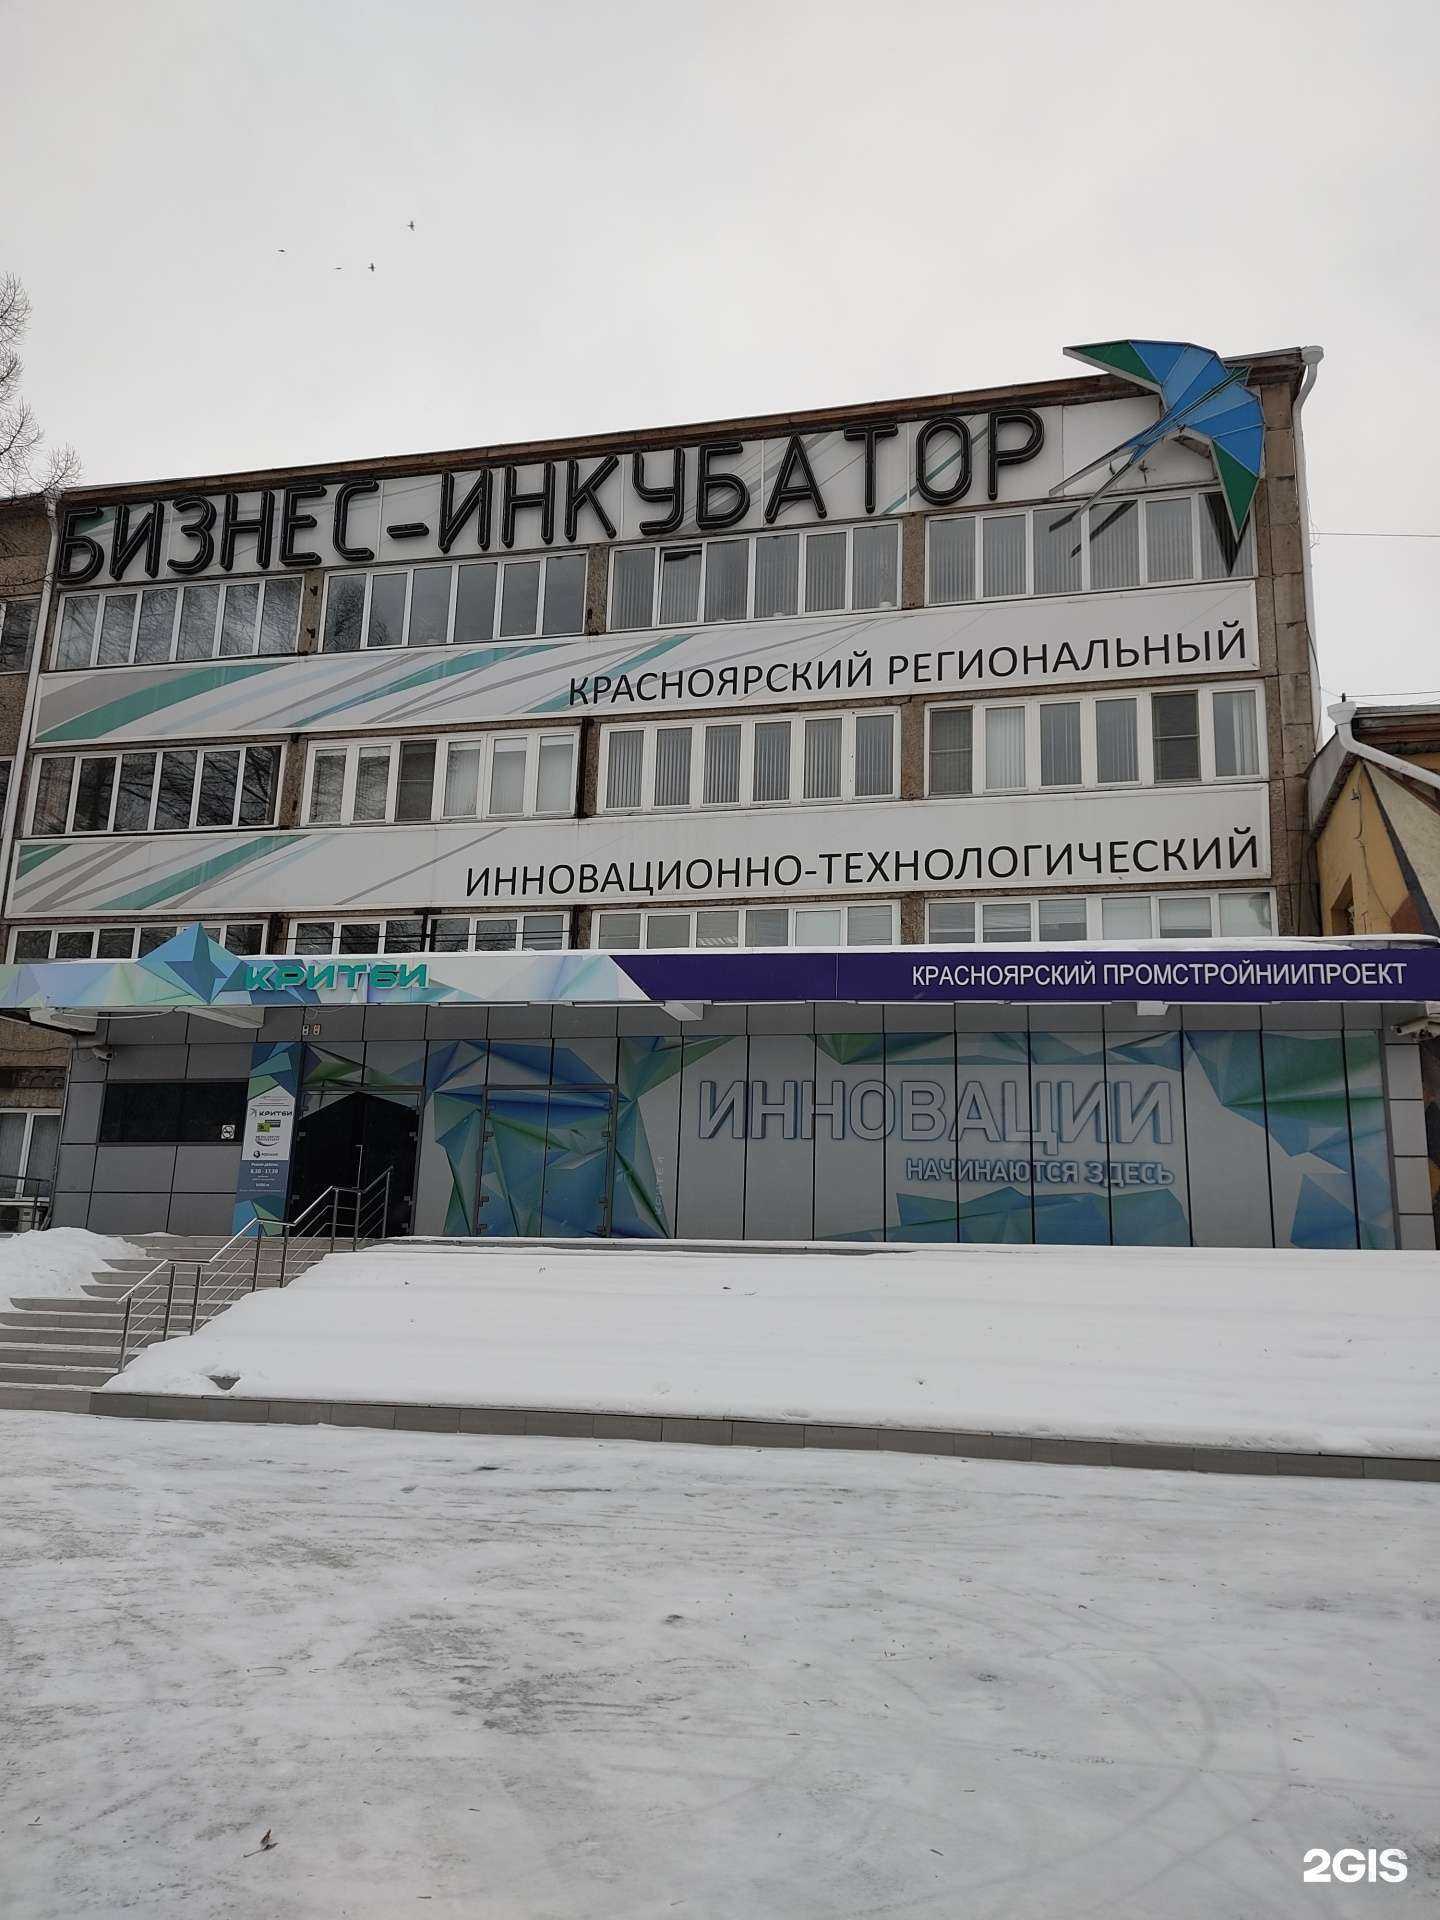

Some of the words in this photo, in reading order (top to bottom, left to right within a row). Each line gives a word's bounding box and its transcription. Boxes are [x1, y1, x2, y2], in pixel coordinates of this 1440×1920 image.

[56, 406, 1046, 586] БИЗНЕС-ИНКУБАТОР
[569, 649, 872, 706] КРАСНОЯРСКИЙ
[889, 619, 1247, 685] РЕГИОНАЛЬНЫЙ
[466, 826, 1258, 897] ИННОВАЦИОННО-ТЕХНОЛОГИЧЕСКИЙ
[245, 963, 429, 991] КРИТБИ
[911, 960, 1096, 987] КРАСНОЯРСКИЙ
[1103, 959, 1408, 986] ПРОМСТРОЙНИИПРОЕКТ
[698, 1079, 1174, 1156] ИННОВАЦИИ
[905, 1157, 1079, 1185] НАЧИНАЮТСЯ
[1085, 1159, 1175, 1186] ЗДЕСЬ
